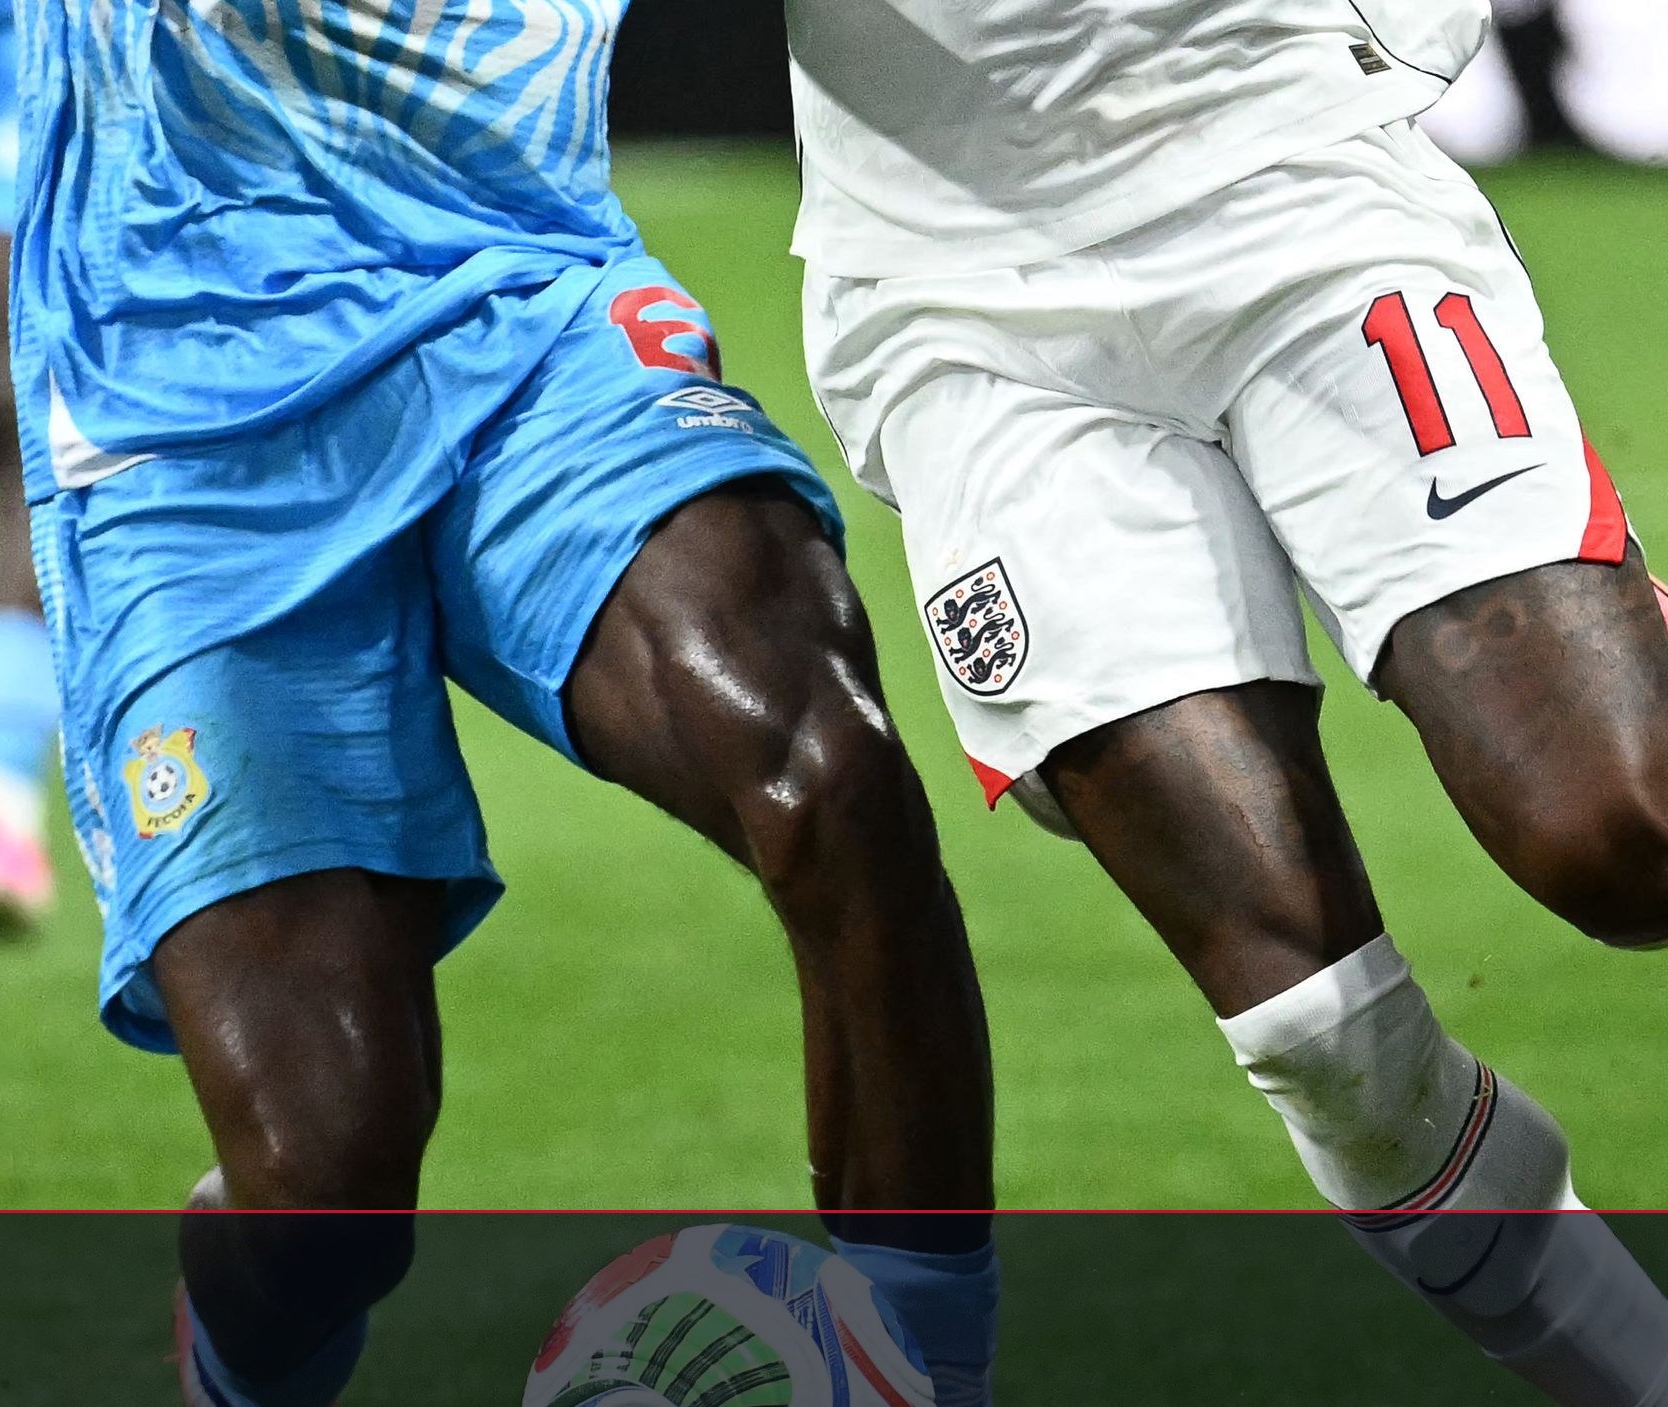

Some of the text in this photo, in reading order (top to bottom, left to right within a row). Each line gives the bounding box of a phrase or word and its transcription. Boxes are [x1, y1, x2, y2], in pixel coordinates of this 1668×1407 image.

[608, 286, 723, 382] 6
[1361, 290, 1533, 458] 11
[677, 414, 754, 435] umbro
